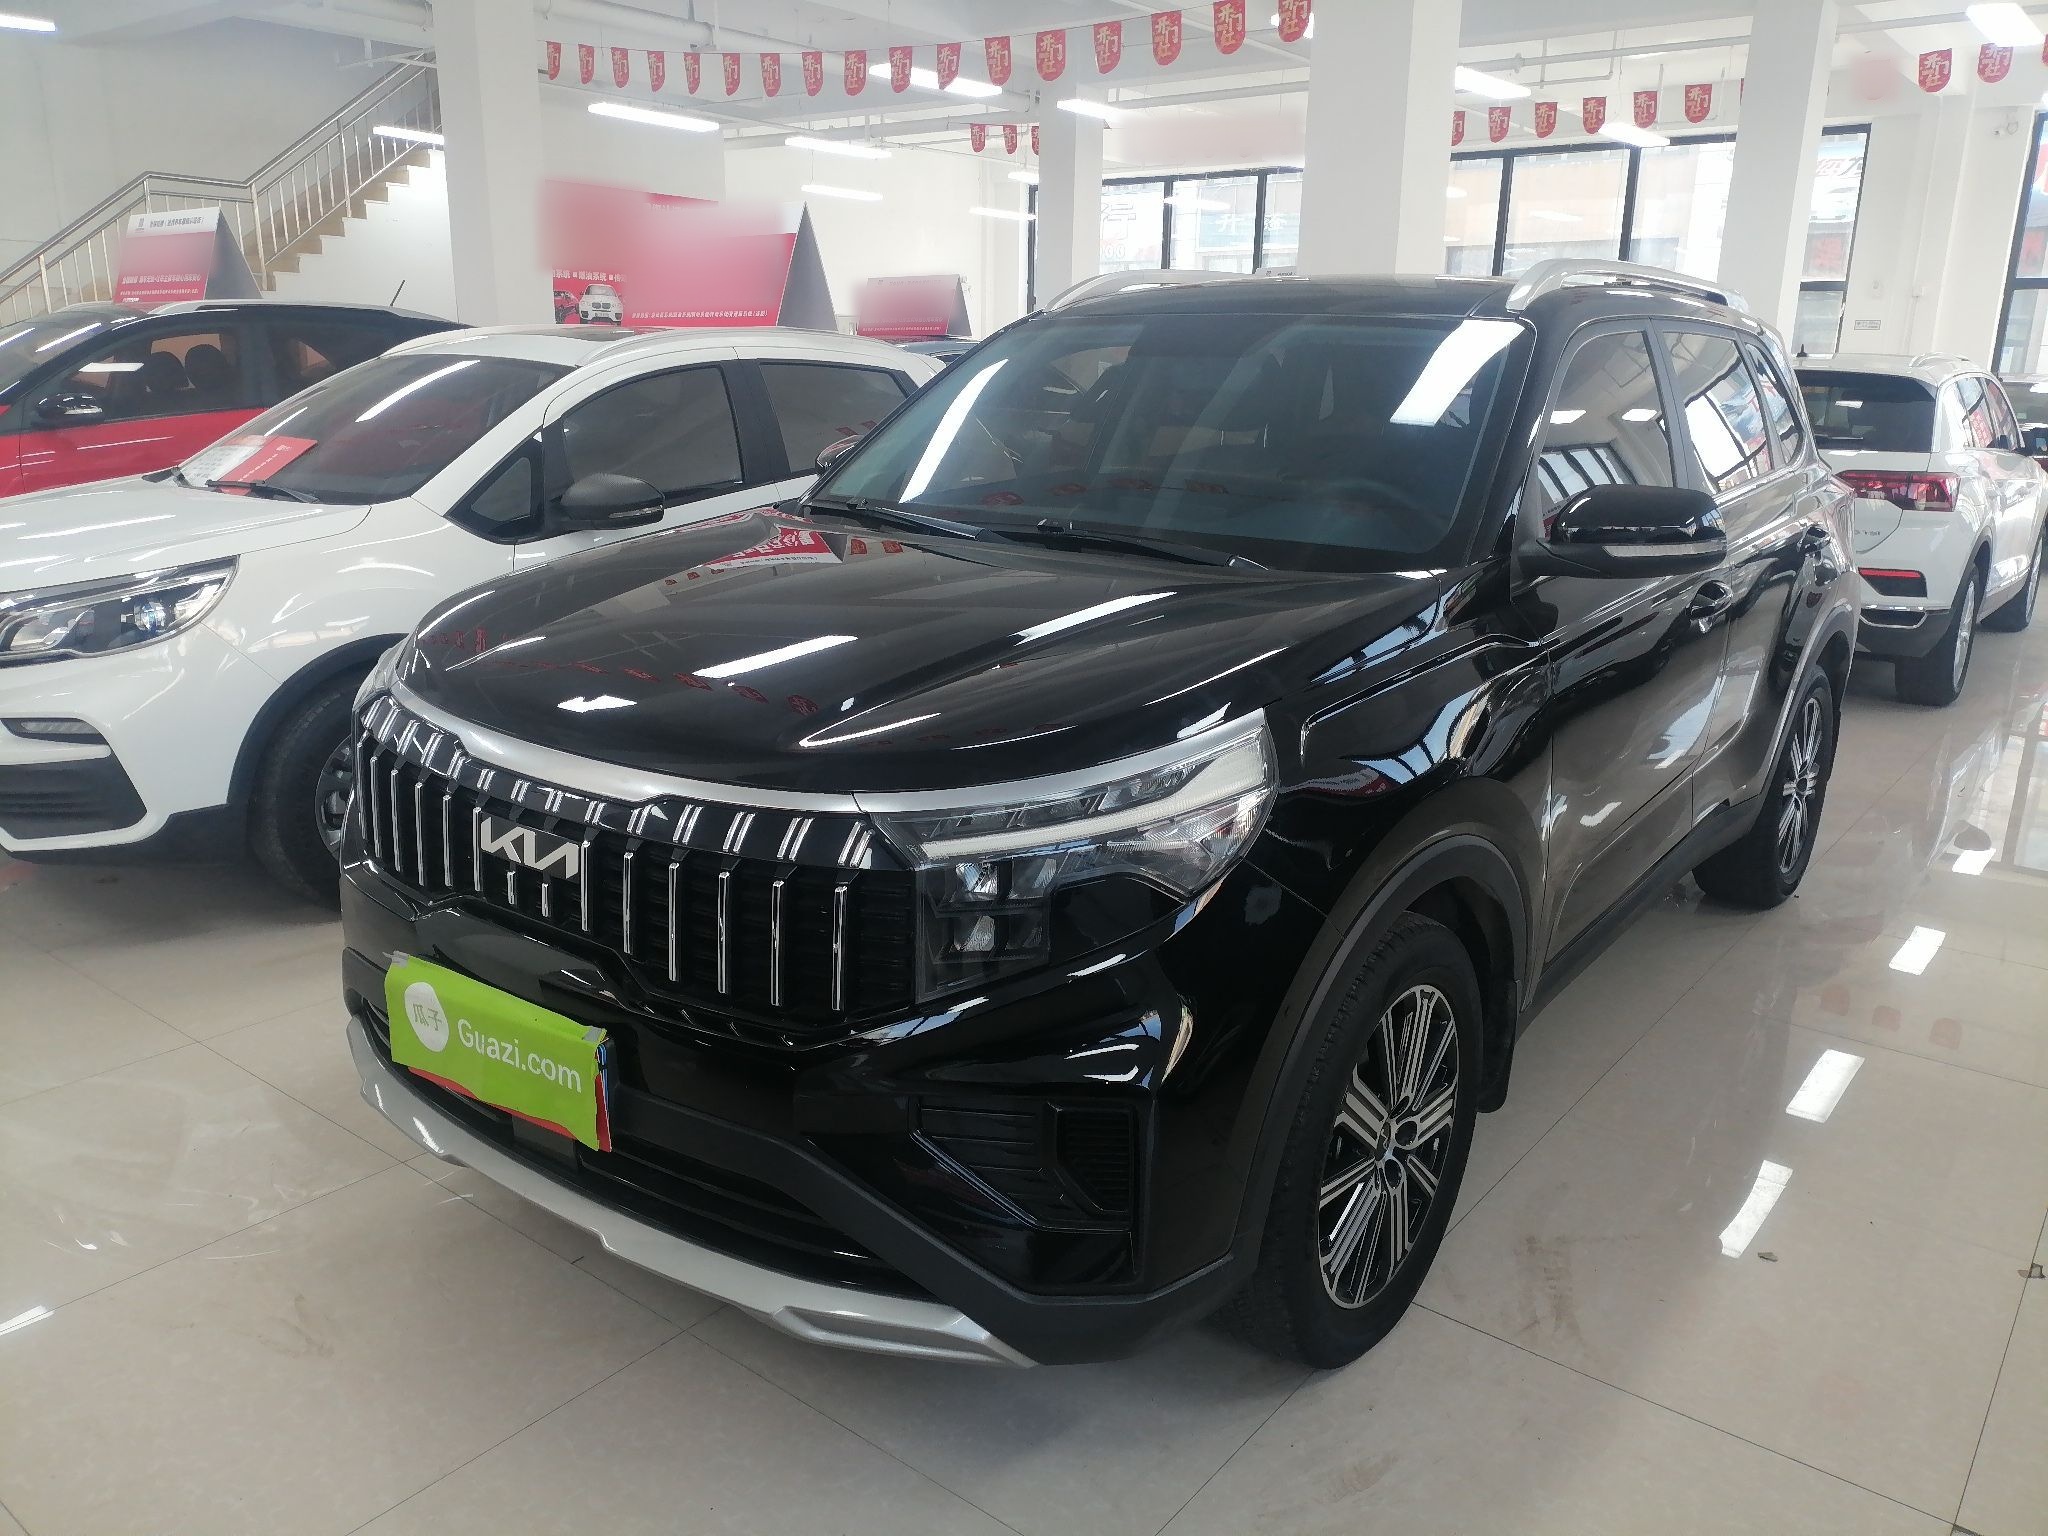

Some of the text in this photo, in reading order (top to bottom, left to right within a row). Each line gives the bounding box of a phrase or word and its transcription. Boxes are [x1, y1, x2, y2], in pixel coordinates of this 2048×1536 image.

[1154, 16, 1178, 57] 开门红
[1216, 3, 1242, 45] 开门红
[1040, 35, 1063, 73] 开门红
[1097, 26, 1118, 65] 开门红
[412, 1003, 442, 1031] 瓜子
[457, 1018, 582, 1094] Guazi.com
